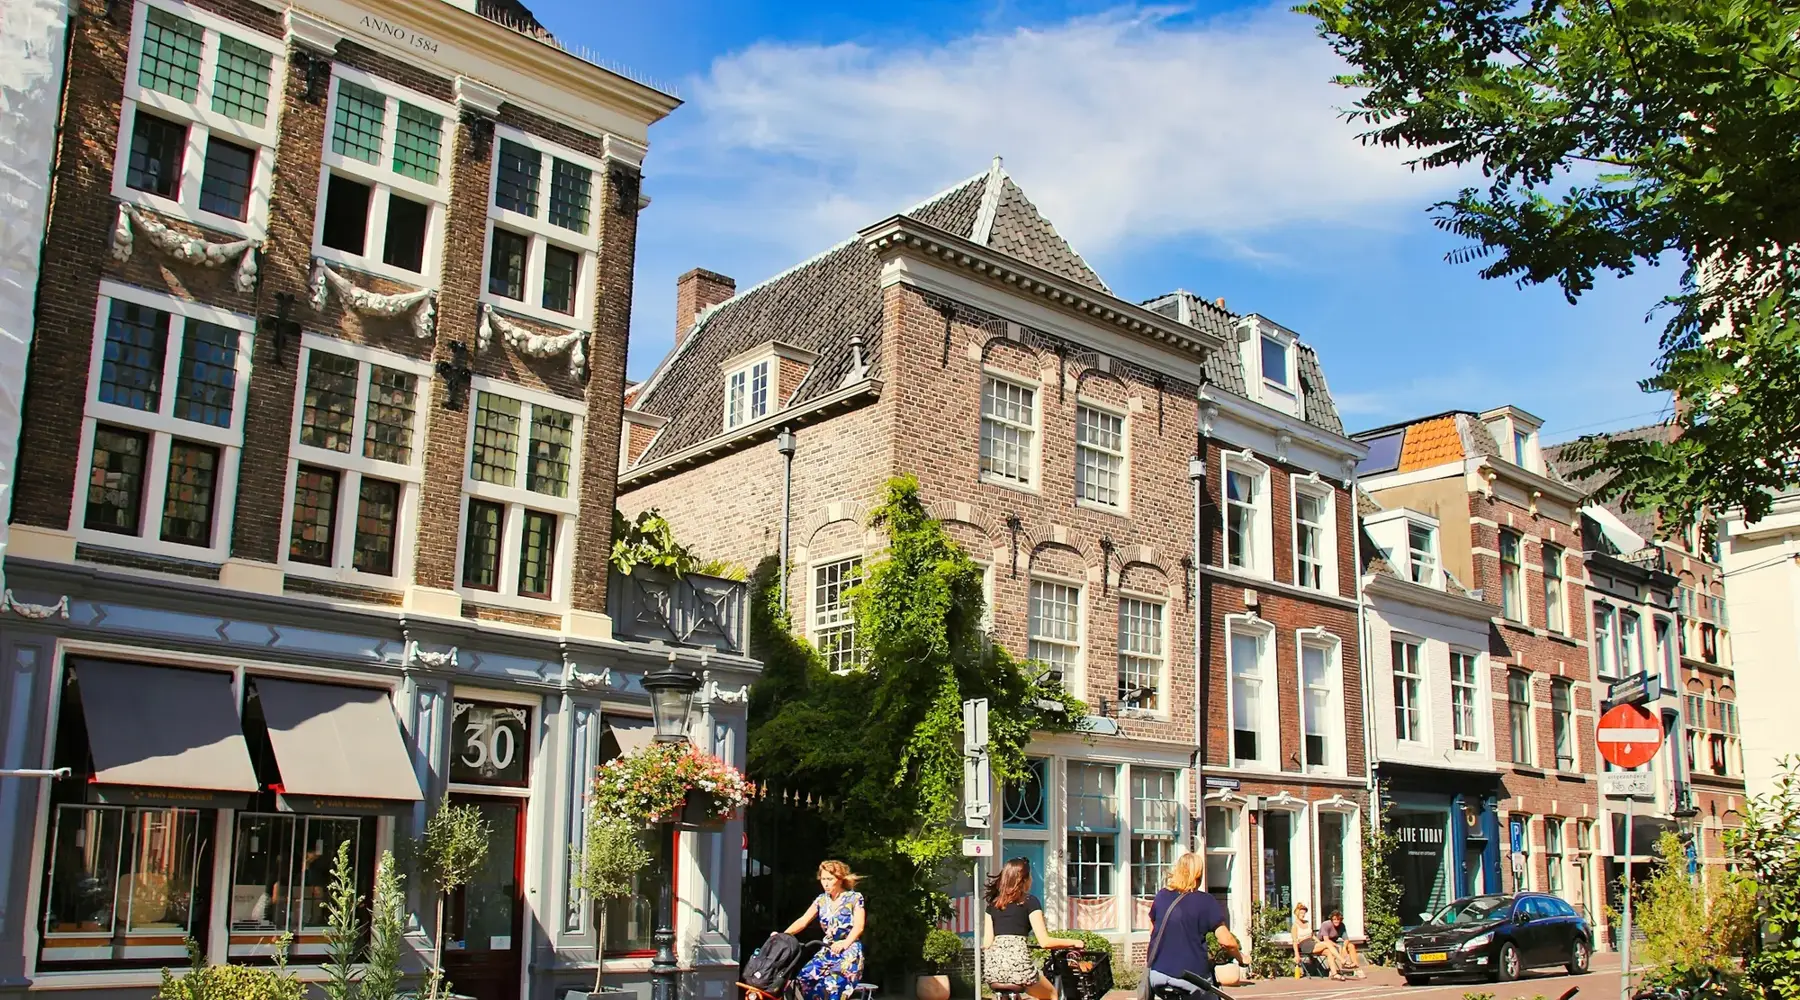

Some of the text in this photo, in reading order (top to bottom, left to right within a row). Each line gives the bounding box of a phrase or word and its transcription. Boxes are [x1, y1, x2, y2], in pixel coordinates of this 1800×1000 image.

[360, 15, 439, 54] ANNO 1584
[461, 723, 515, 770] 30
[1398, 827, 1443, 844] LIVE TODAY
[1514, 825, 1520, 841] P
